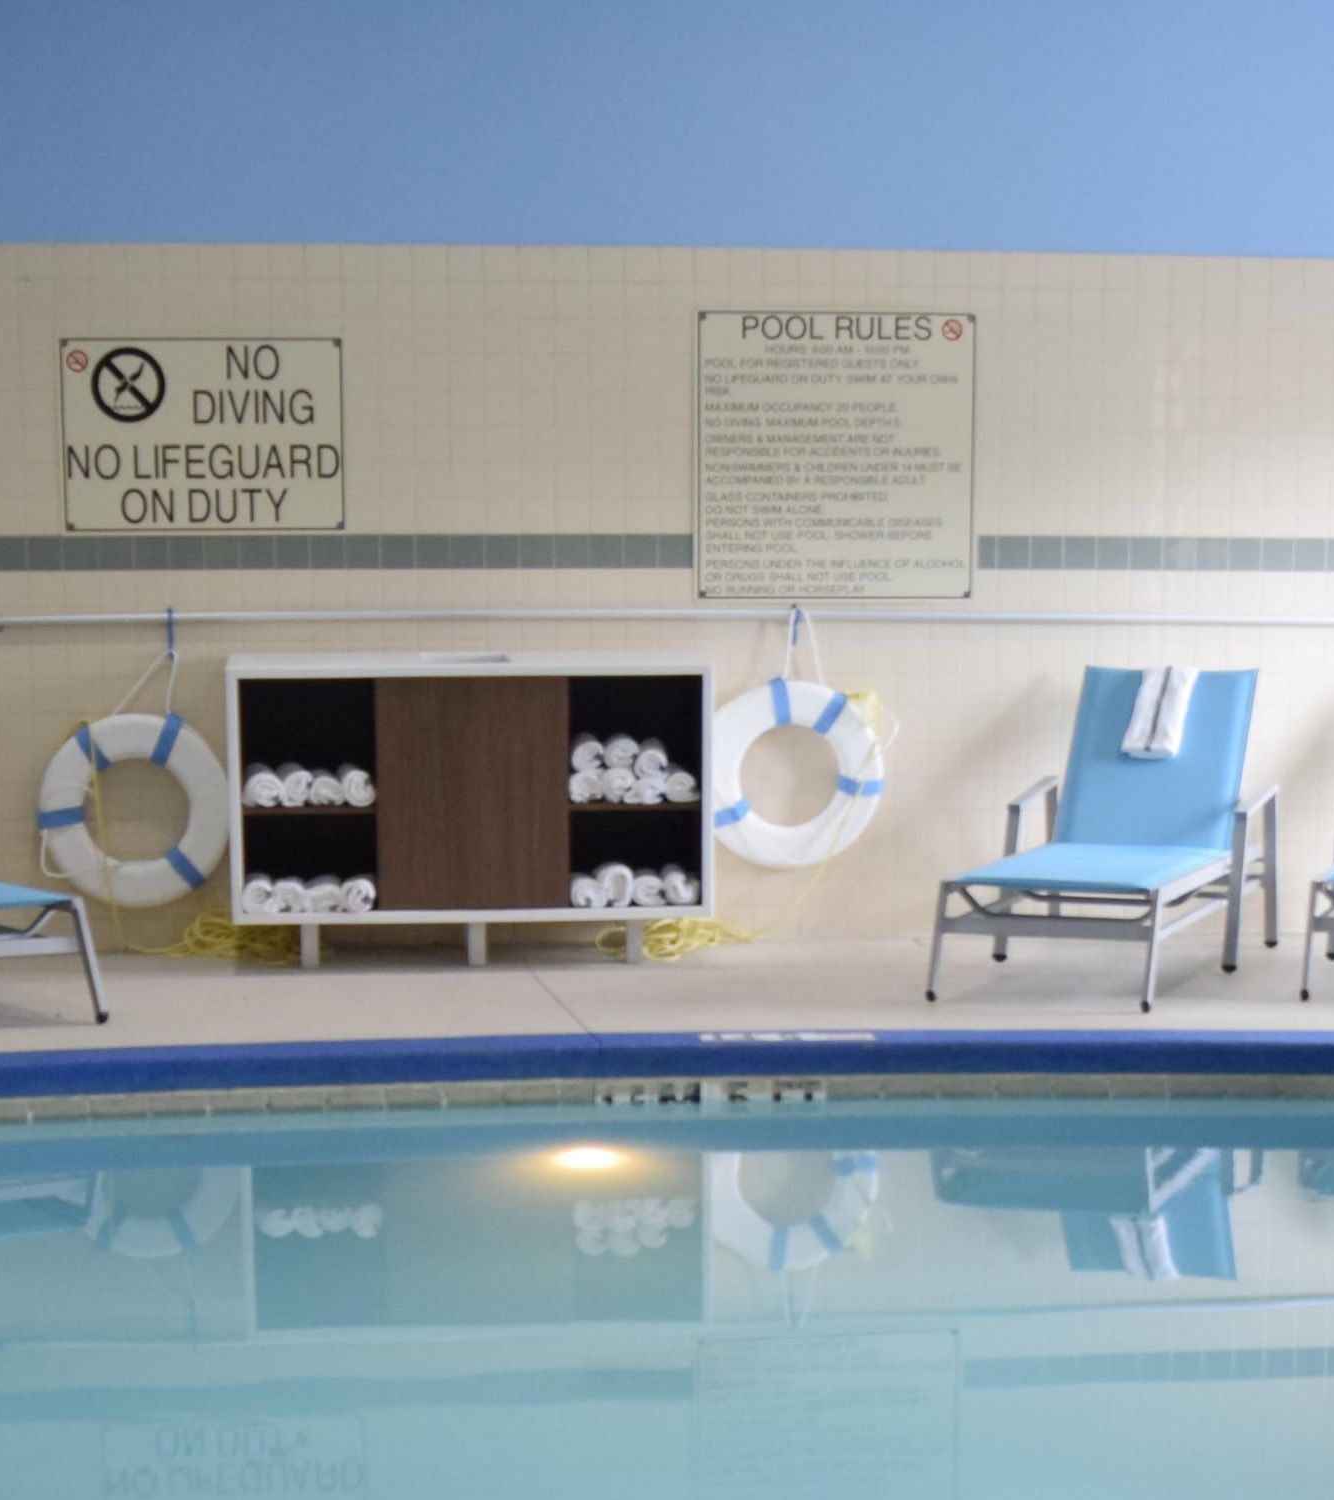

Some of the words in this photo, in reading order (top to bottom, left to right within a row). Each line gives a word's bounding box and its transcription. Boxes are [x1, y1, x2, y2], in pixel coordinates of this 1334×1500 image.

[741, 315, 824, 340] POOL
[834, 316, 932, 341] RULES
[226, 345, 279, 380] NO
[193, 390, 314, 425] DIVING
[67, 444, 120, 480] NO
[133, 444, 339, 480] LIFEGUARD
[121, 488, 174, 523] ON
[188, 488, 287, 523] DUTY
